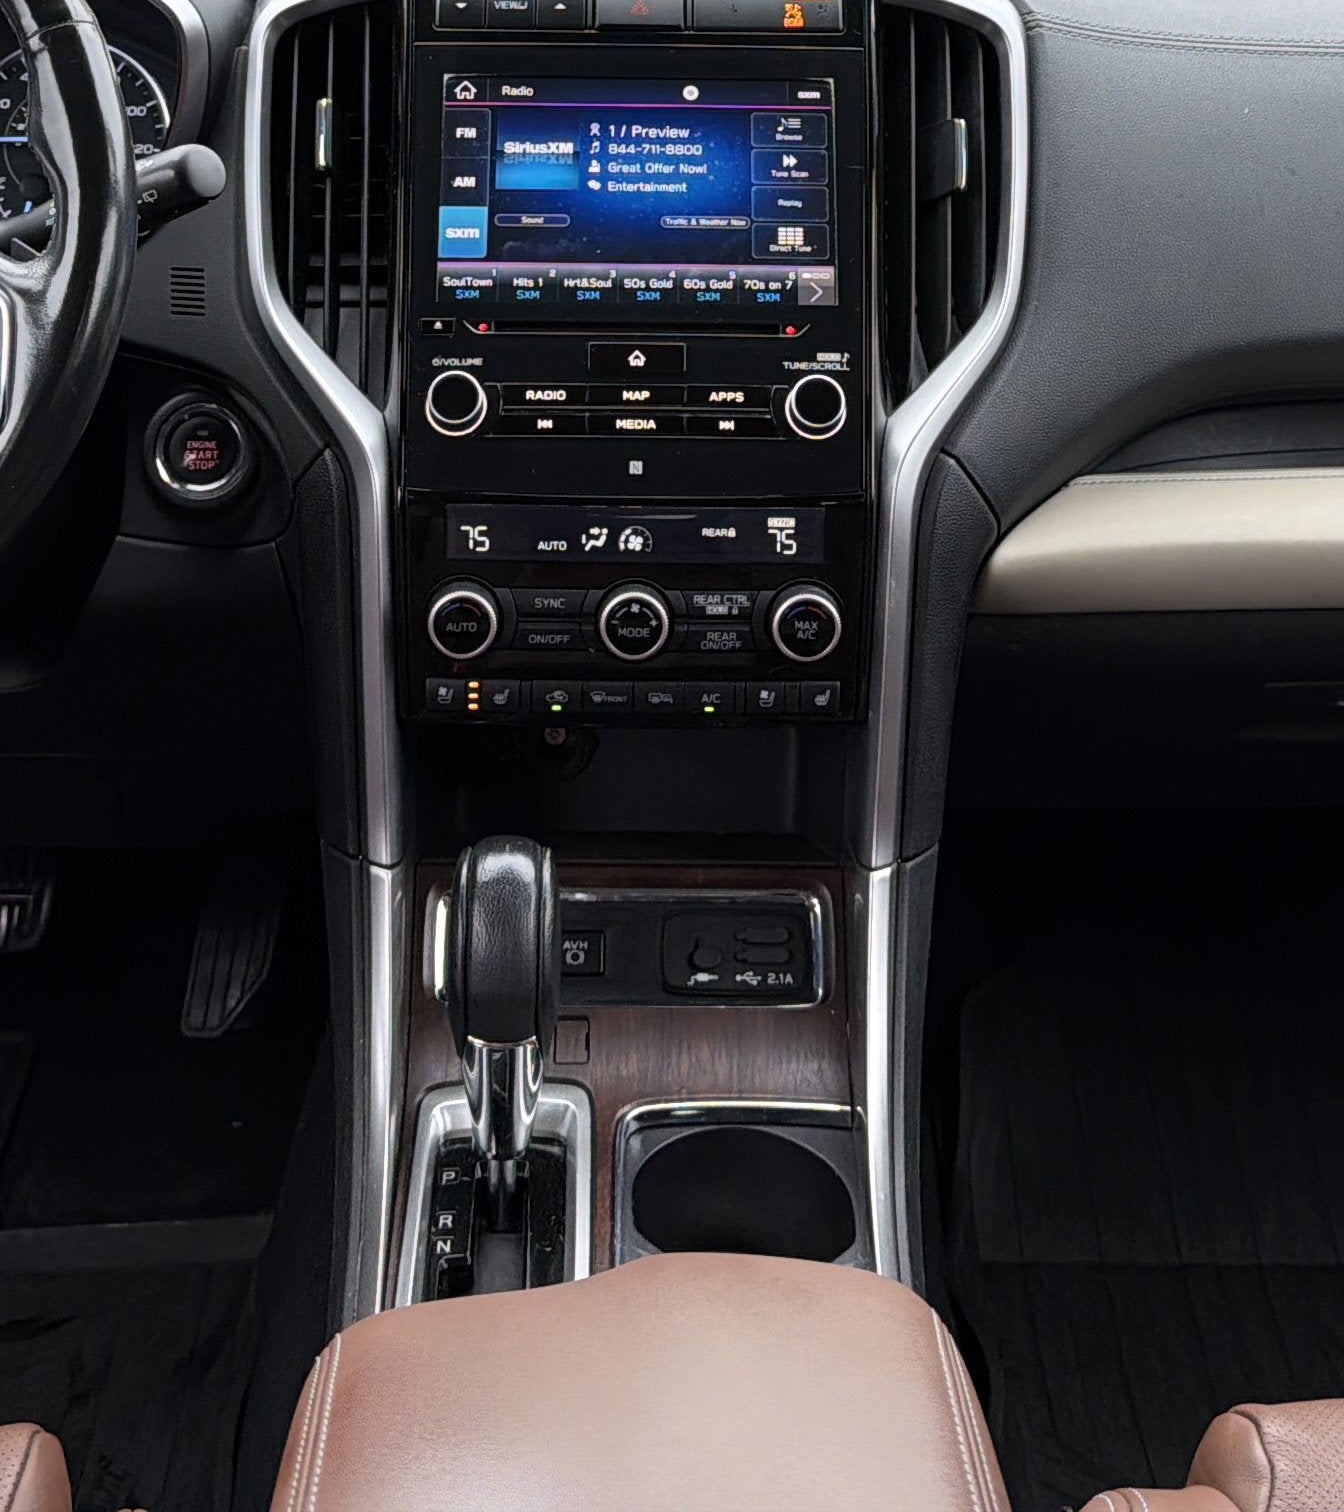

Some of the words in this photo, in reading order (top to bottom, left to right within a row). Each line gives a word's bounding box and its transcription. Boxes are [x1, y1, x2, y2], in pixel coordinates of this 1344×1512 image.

[501, 85, 534, 97] Radio
[126, 106, 147, 117] 00
[456, 127, 477, 139] FM
[608, 125, 615, 138] 1
[631, 125, 690, 139] Preview
[133, 144, 153, 154] 20
[504, 141, 574, 155] SiriusXM
[608, 144, 703, 156] 844-711-8800
[608, 162, 642, 174] Great
[645, 162, 675, 174] Offer
[679, 163, 708, 174] Now!
[453, 176, 476, 188] AM
[608, 181, 687, 193] Entertainment
[520, 216, 544, 225] Sound
[445, 228, 480, 239] sxm
[491, 268, 497, 276] 1
[549, 269, 557, 277] 2
[609, 270, 617, 278] 3
[669, 270, 676, 279] 4
[729, 271, 736, 279] 5
[789, 271, 796, 280] 6
[442, 277, 493, 287] SoulTown
[512, 277, 534, 287] Hits
[538, 277, 543, 287] 1
[623, 278, 646, 289] 50s
[649, 278, 674, 289] Gold
[683, 279, 706, 289] 60s
[709, 279, 733, 289] Gold
[743, 279, 766, 290] 70s
[768, 281, 782, 290] on
[785, 280, 793, 290] 7
[455, 290, 480, 300] SXM
[516, 290, 540, 300] SXM
[576, 291, 601, 301] SXM
[636, 291, 661, 301] SXM
[696, 292, 721, 301] SXM
[756, 292, 781, 302] SXM
[525, 390, 567, 401] RADIO
[622, 390, 651, 402] MAP
[709, 391, 745, 403] APPS
[616, 418, 657, 430] MEDIA
[186, 440, 218, 449] ENGINE
[188, 460, 216, 470] STOP
[701, 527, 728, 538] REAR
[461, 525, 491, 552] 75
[767, 529, 797, 555] 75
[537, 540, 568, 552] AUTO
[534, 598, 566, 609] SYNC
[693, 595, 721, 605] REAR
[723, 595, 750, 605] CTRL
[446, 622, 478, 633] AUTO
[794, 620, 819, 631] MAX
[618, 627, 651, 638] MODE
[707, 632, 737, 642] REAR
[796, 630, 817, 641] A/C
[528, 634, 571, 646] ON/OFF
[700, 640, 743, 651] ON/OFF
[701, 693, 721, 705] A/C
[563, 940, 589, 951] AVH
[766, 973, 794, 986] 2.1A
[441, 1170, 456, 1185] P
[438, 1214, 453, 1229] R
[436, 1239, 451, 1254] N
